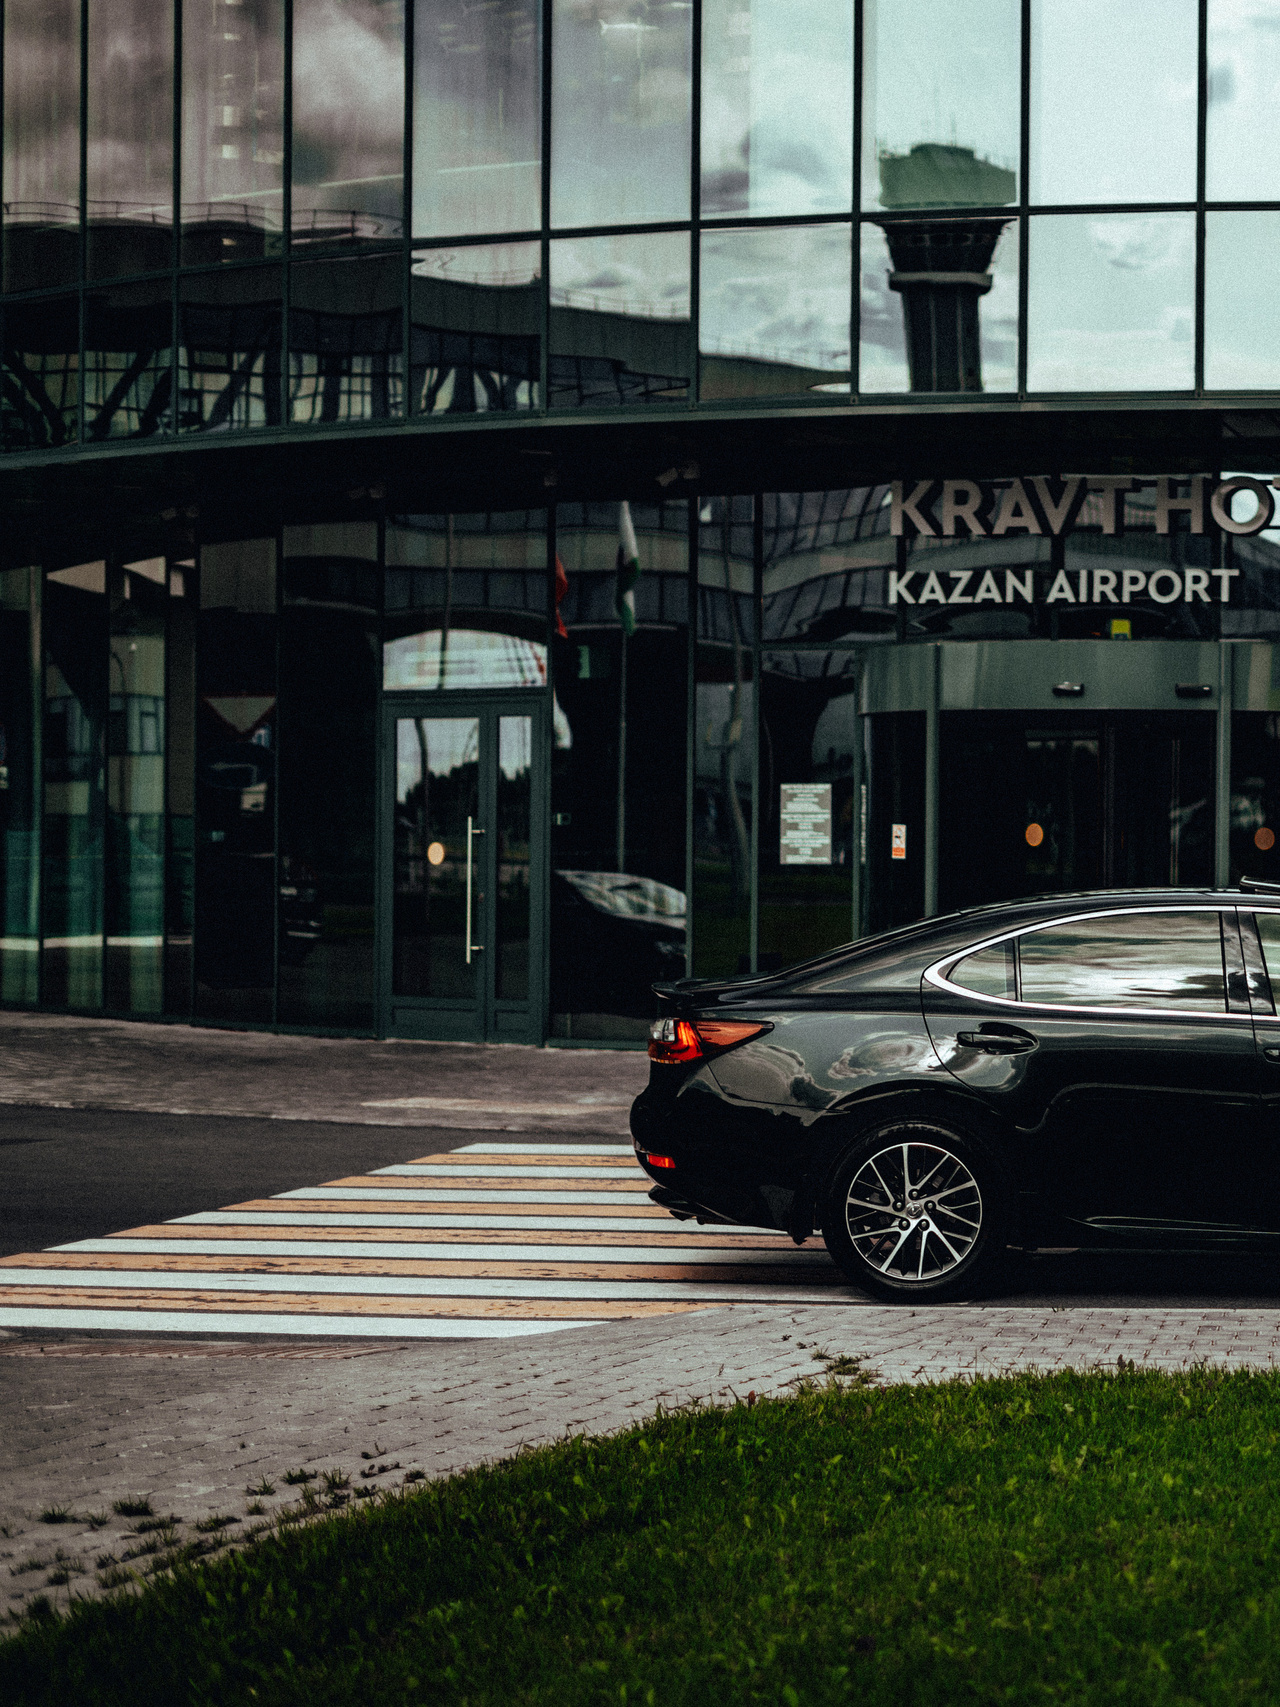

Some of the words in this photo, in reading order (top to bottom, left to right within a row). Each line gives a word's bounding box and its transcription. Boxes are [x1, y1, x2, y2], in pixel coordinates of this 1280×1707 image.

[889, 477, 1135, 535] KRAVT
[888, 570, 1034, 604] KAZAN
[1046, 569, 1240, 603] AIRPORT
